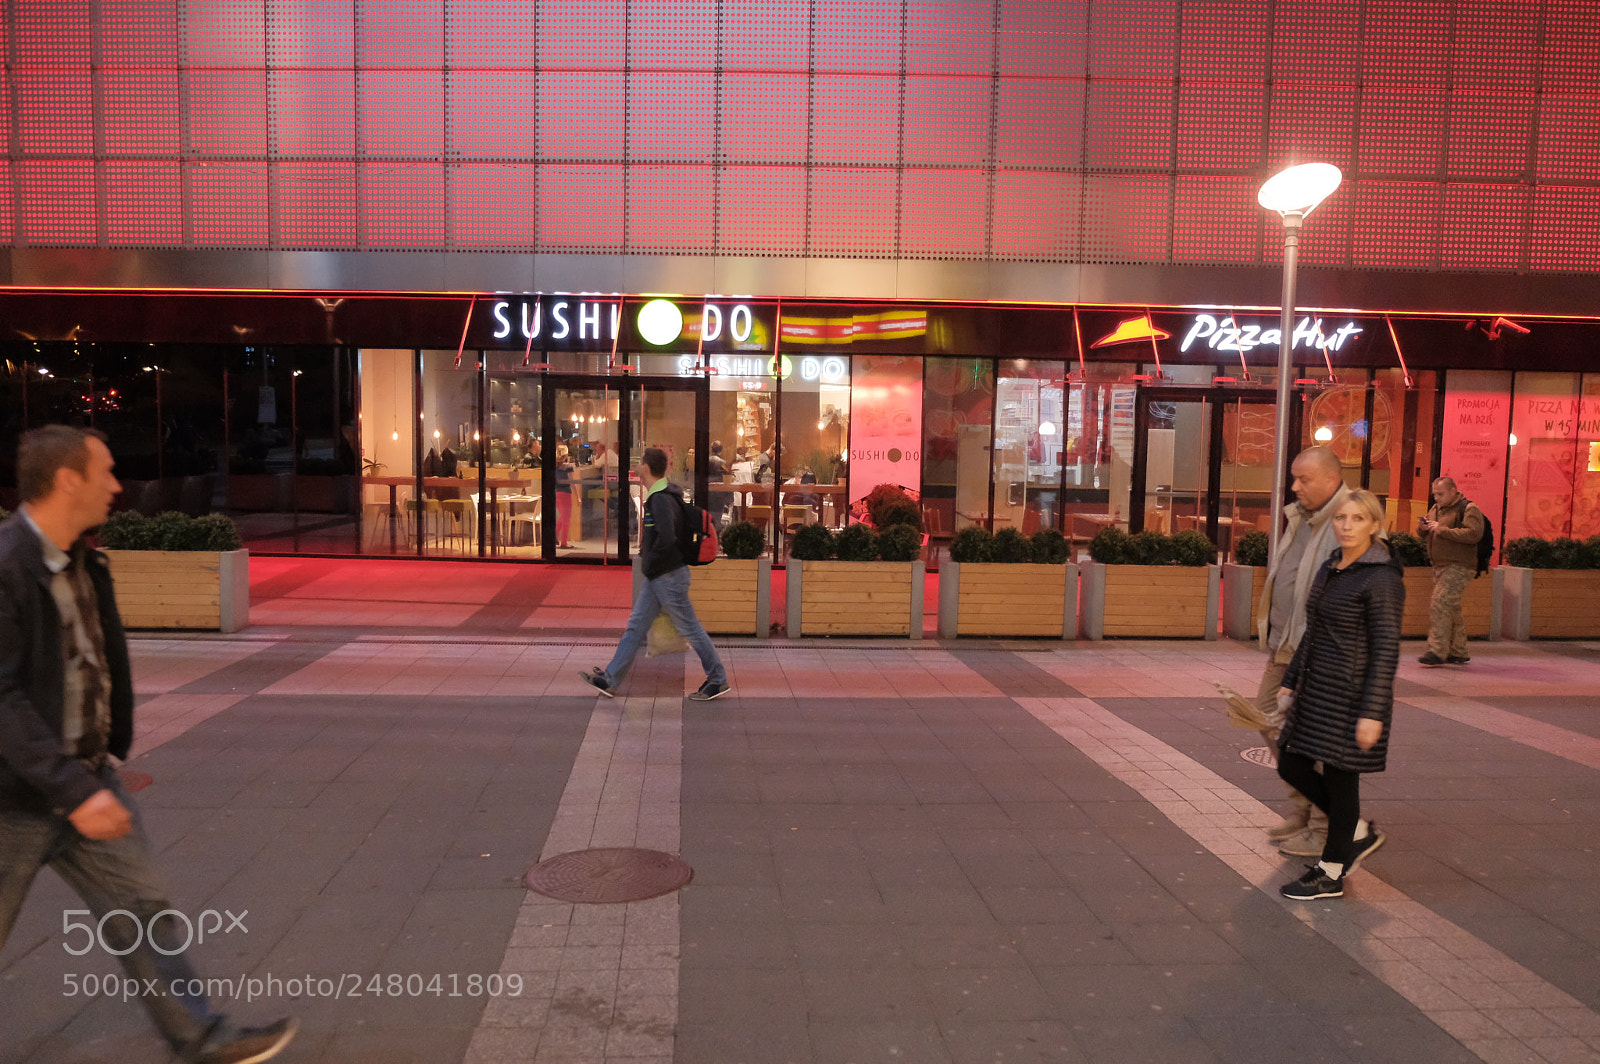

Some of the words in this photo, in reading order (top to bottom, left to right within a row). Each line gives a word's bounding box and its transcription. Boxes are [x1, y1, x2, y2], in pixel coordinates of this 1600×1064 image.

[493, 302, 619, 340] SUSHI
[702, 304, 752, 342] DO
[1180, 314, 1281, 352] Pizza
[1291, 316, 1364, 351] Hut
[679, 355, 763, 378] SSHI
[802, 358, 846, 380] DO
[1457, 398, 1500, 410] PROMOCJA
[1528, 400, 1563, 414] PIZZA
[1570, 400, 1587, 415] NA
[1459, 413, 1472, 425] NA
[1545, 420, 1554, 431] W
[1558, 420, 1572, 436] 15
[851, 450, 885, 460] SUSHI
[905, 451, 920, 461] DO
